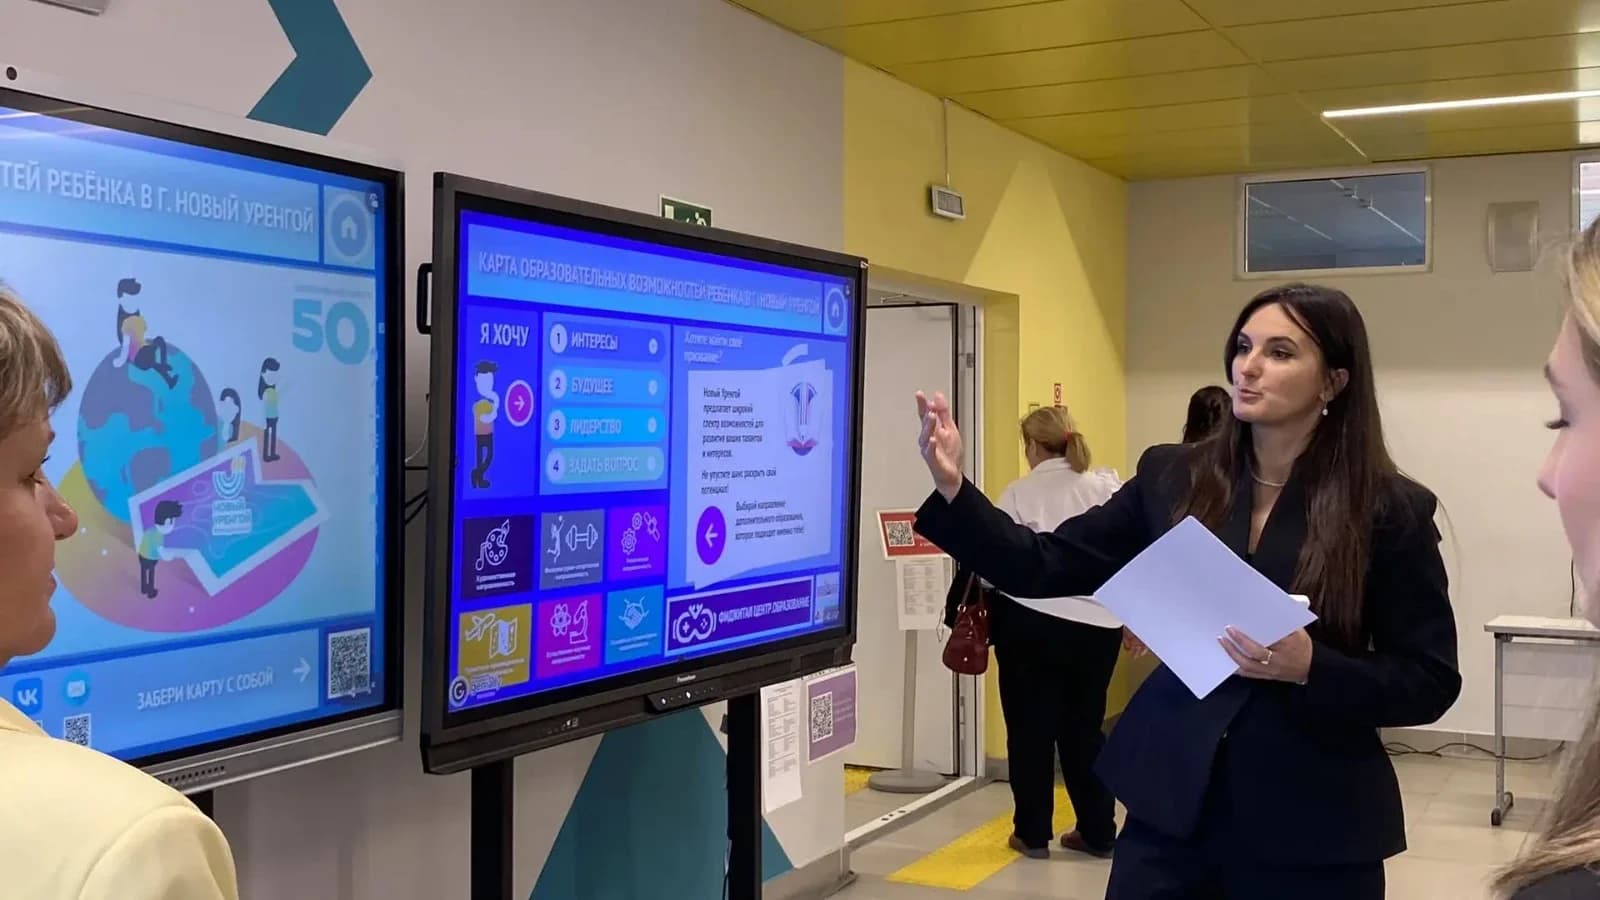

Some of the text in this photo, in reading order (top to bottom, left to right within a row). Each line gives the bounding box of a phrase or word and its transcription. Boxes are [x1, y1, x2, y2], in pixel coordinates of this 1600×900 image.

[49, 168, 136, 207] РЕБЁНКА
[141, 186, 152, 209] В
[156, 191, 172, 213] Г.
[175, 190, 239, 220] НОВЫЙ
[243, 202, 313, 233] УРЕНГОЙ
[479, 251, 518, 276] КАРТА
[520, 255, 628, 290] ОБРАЗОВАТЕЛЬНЫХ
[628, 269, 705, 300] ВОЗМОЖНОСТЕЙ
[292, 298, 370, 365] 50
[480, 322, 529, 347] Я ХОЧУ
[571, 331, 618, 350] ИНТЕРЕСЫ
[571, 376, 613, 394] БУДУЩЕЕ
[570, 419, 622, 437] ЛИДЕРСТВО
[569, 458, 602, 474] ЗАДАТЬ
[605, 457, 639, 473] ВОПРОС
[137, 666, 274, 711] ЗАБЕРИ КАРТУ С СОБОЙ
